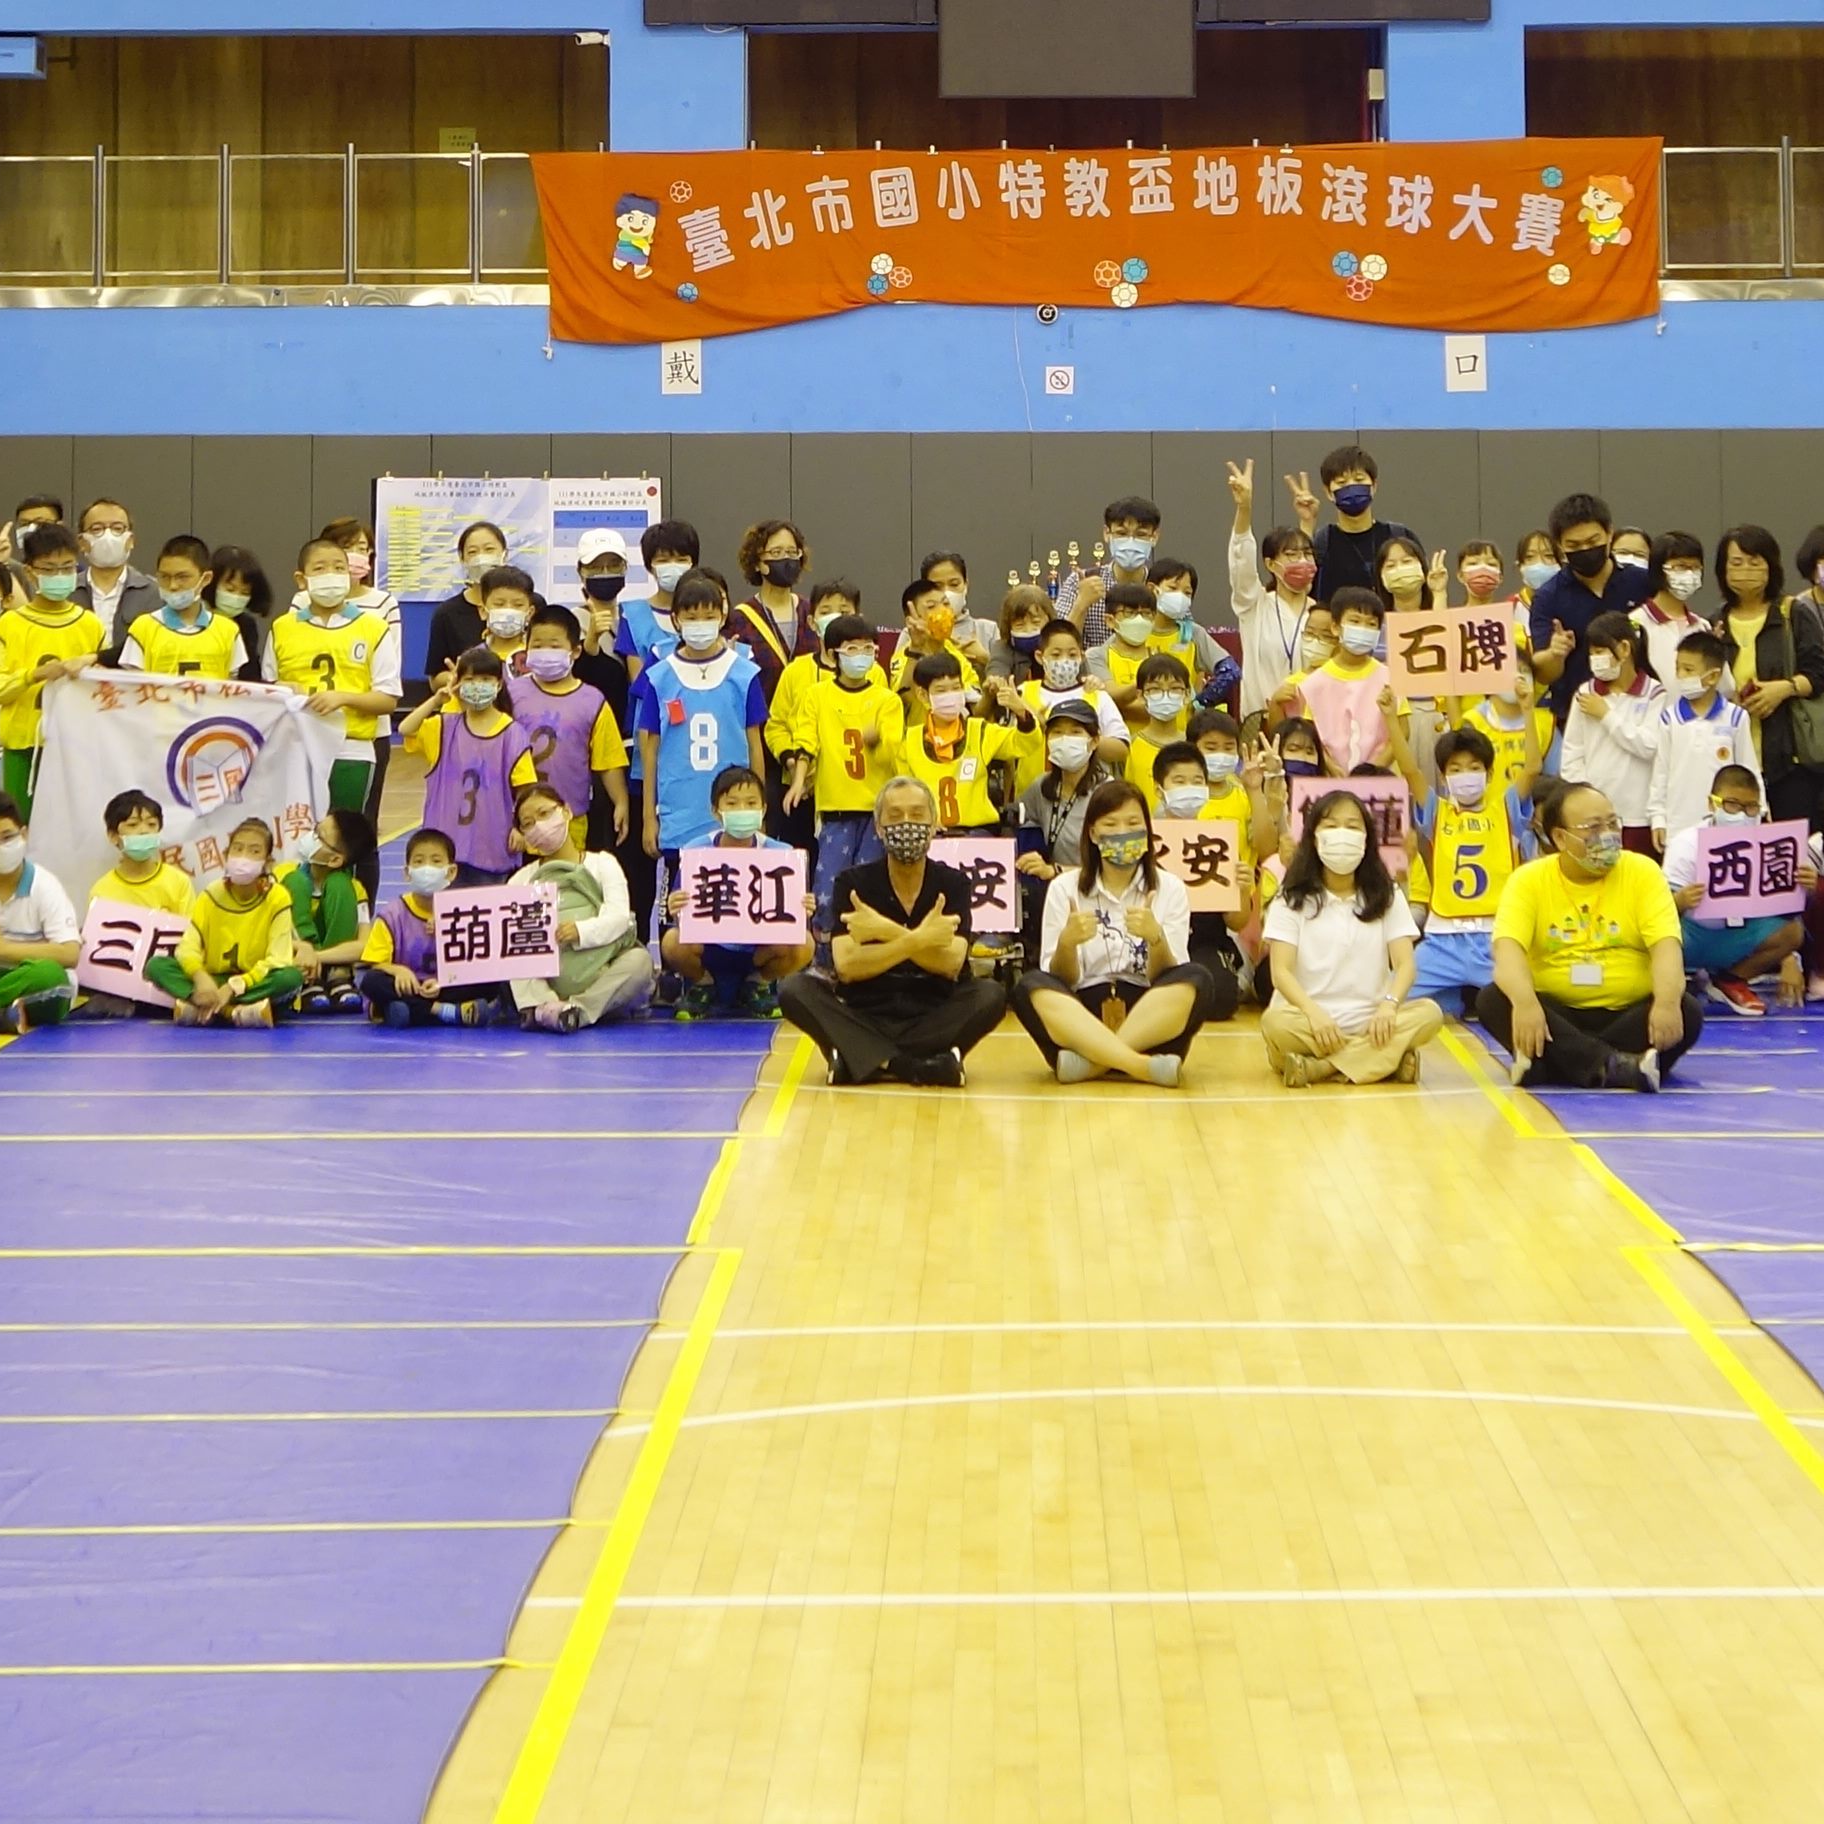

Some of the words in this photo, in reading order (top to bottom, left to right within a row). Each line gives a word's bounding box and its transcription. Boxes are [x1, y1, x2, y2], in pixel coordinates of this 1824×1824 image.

[677, 153, 1565, 273] 臺北市國小特教盃地板滾球大賽
[665, 350, 699, 385] 戴
[1455, 354, 1479, 375] 口
[1398, 618, 1508, 675] 石牌
[690, 713, 718, 771] 8
[843, 728, 867, 781] 3
[457, 767, 480, 826] 3
[692, 862, 797, 925] 華江
[1451, 844, 1489, 900] 5
[1707, 835, 1798, 900] 西園
[223, 942, 240, 975] 1
[440, 898, 555, 963] 葫蘆
